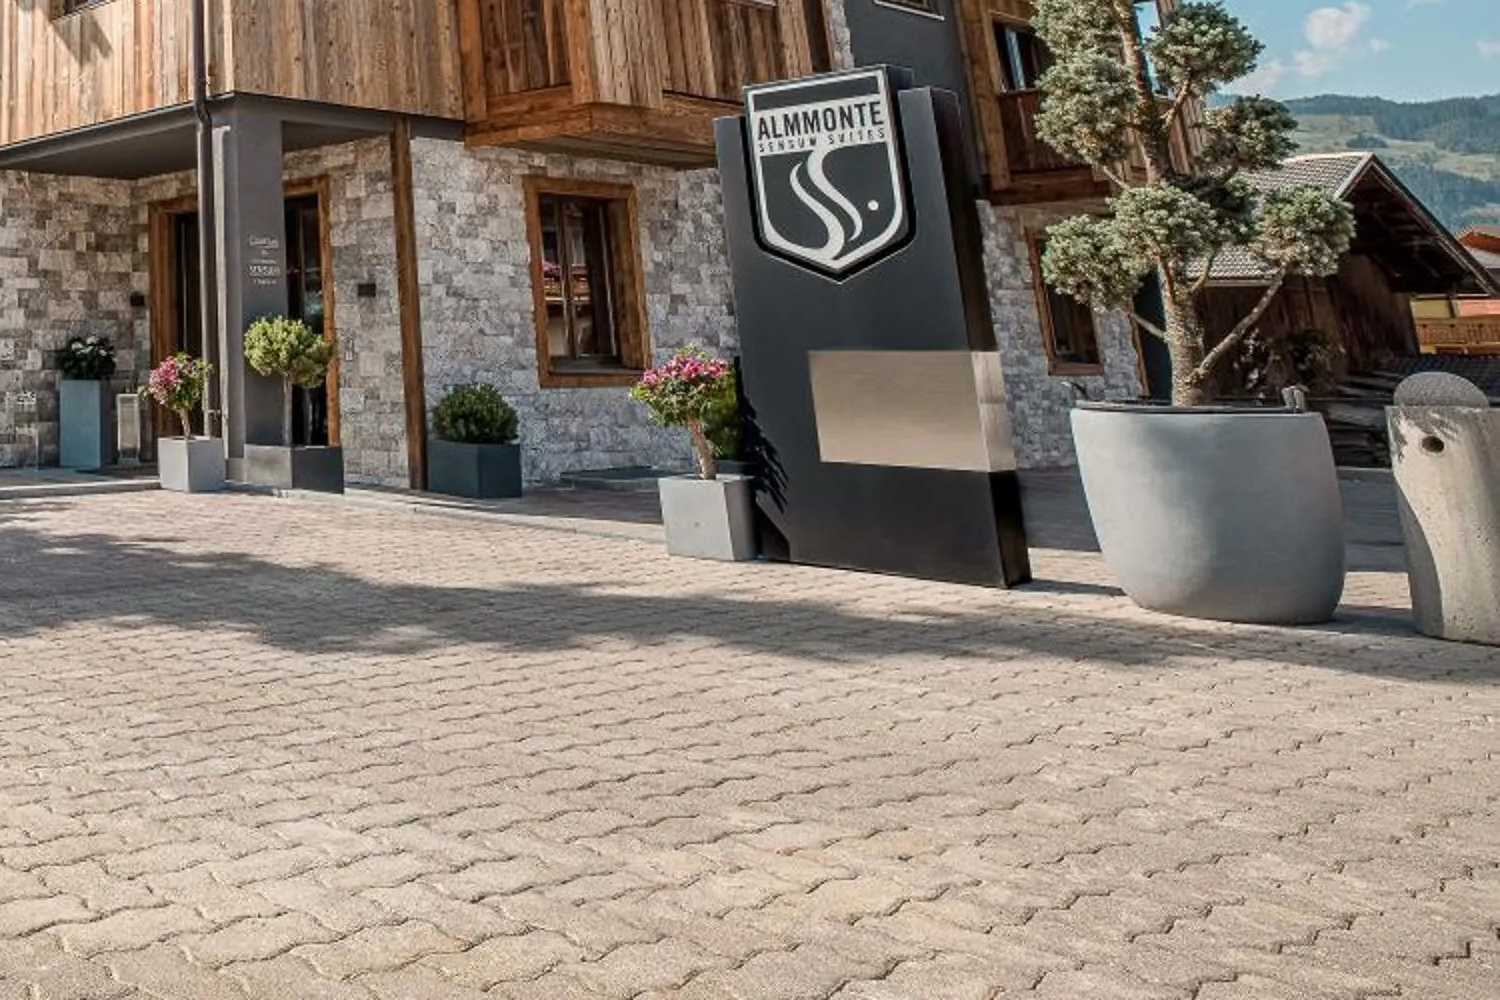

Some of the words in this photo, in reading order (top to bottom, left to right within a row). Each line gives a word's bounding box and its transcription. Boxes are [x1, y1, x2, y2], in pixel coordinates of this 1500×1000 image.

[758, 101, 885, 141] ALMMONTE
[759, 137, 817, 153] SENSUM
[828, 128, 885, 145] SUITES
